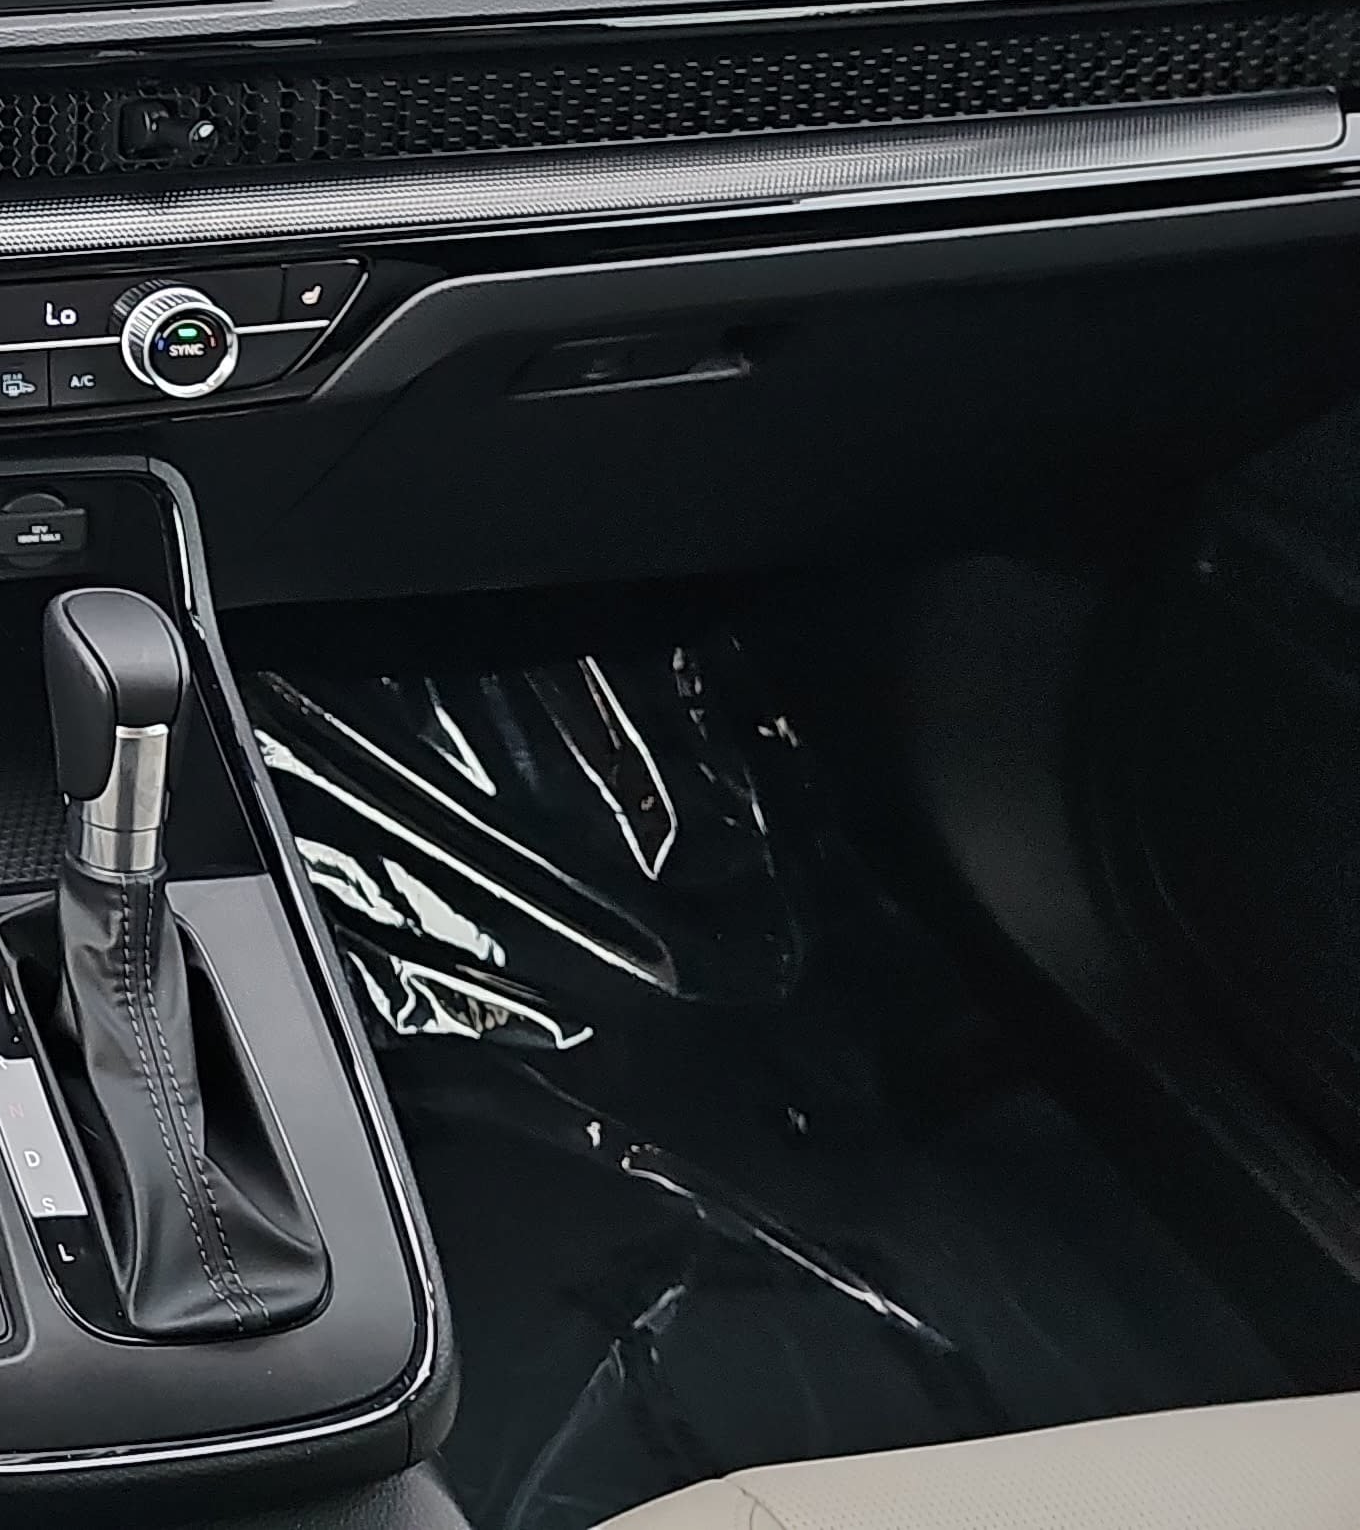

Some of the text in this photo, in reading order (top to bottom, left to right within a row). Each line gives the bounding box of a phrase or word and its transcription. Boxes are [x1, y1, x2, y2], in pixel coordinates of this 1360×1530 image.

[45, 301, 77, 326] Lo
[168, 343, 205, 357] SYNC
[70, 375, 95, 388] A/C
[23, 1150, 41, 1168] D
[41, 1197, 56, 1213] S
[57, 1244, 75, 1262] L
